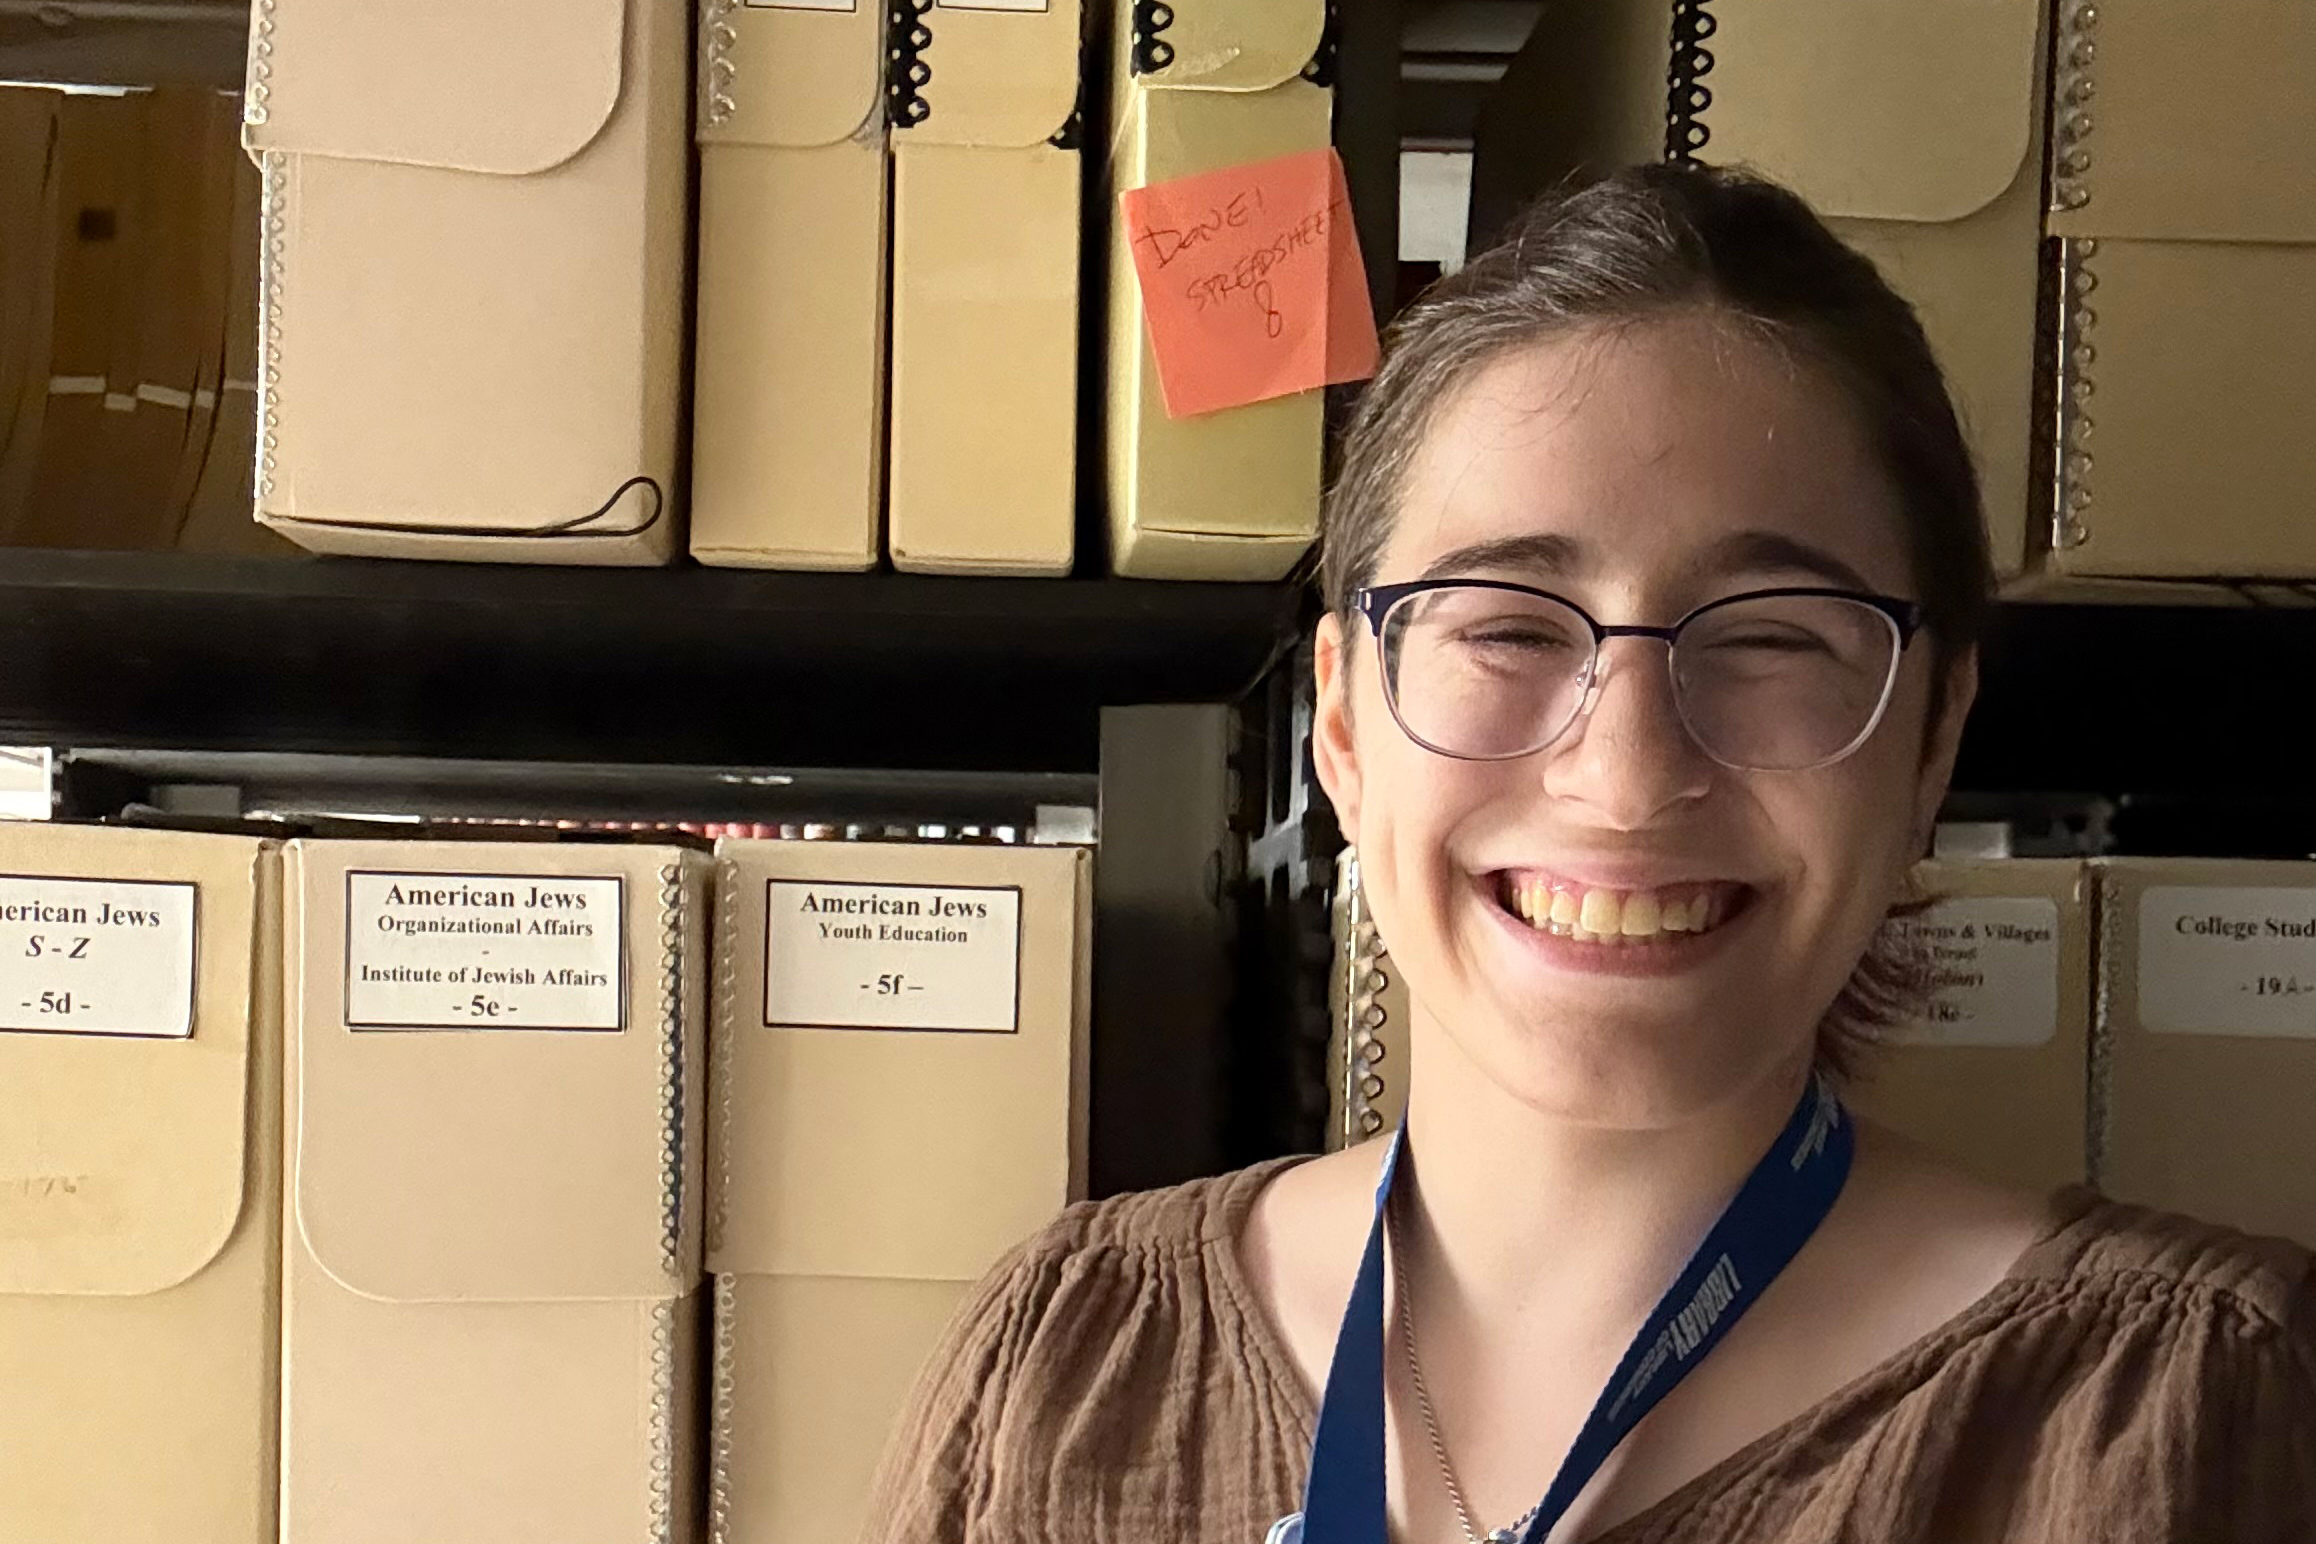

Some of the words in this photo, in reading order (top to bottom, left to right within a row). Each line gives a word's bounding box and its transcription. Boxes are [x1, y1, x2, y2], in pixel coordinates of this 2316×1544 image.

[385, 883, 515, 908] American
[524, 886, 587, 910] Jews
[800, 892, 920, 916] American
[928, 896, 987, 918] Jews
[0, 900, 87, 924] erican
[96, 903, 160, 927] Jews
[377, 915, 521, 936] Organizational
[527, 919, 593, 937] Affairs
[819, 922, 872, 940] Youth
[879, 925, 968, 943] Education
[2175, 915, 2258, 941] College
[2264, 918, 2316, 938] Stud
[25, 935, 45, 957] S
[68, 937, 91, 959] Z
[361, 965, 442, 983] Institute
[448, 967, 468, 983] of
[471, 967, 535, 985] Jewish
[542, 968, 608, 986] Affairs
[877, 974, 905, 995] 5f
[40, 991, 71, 1015] 5d
[470, 994, 500, 1017] 5e
[1669, 1253, 1742, 1361] LIBRARY
